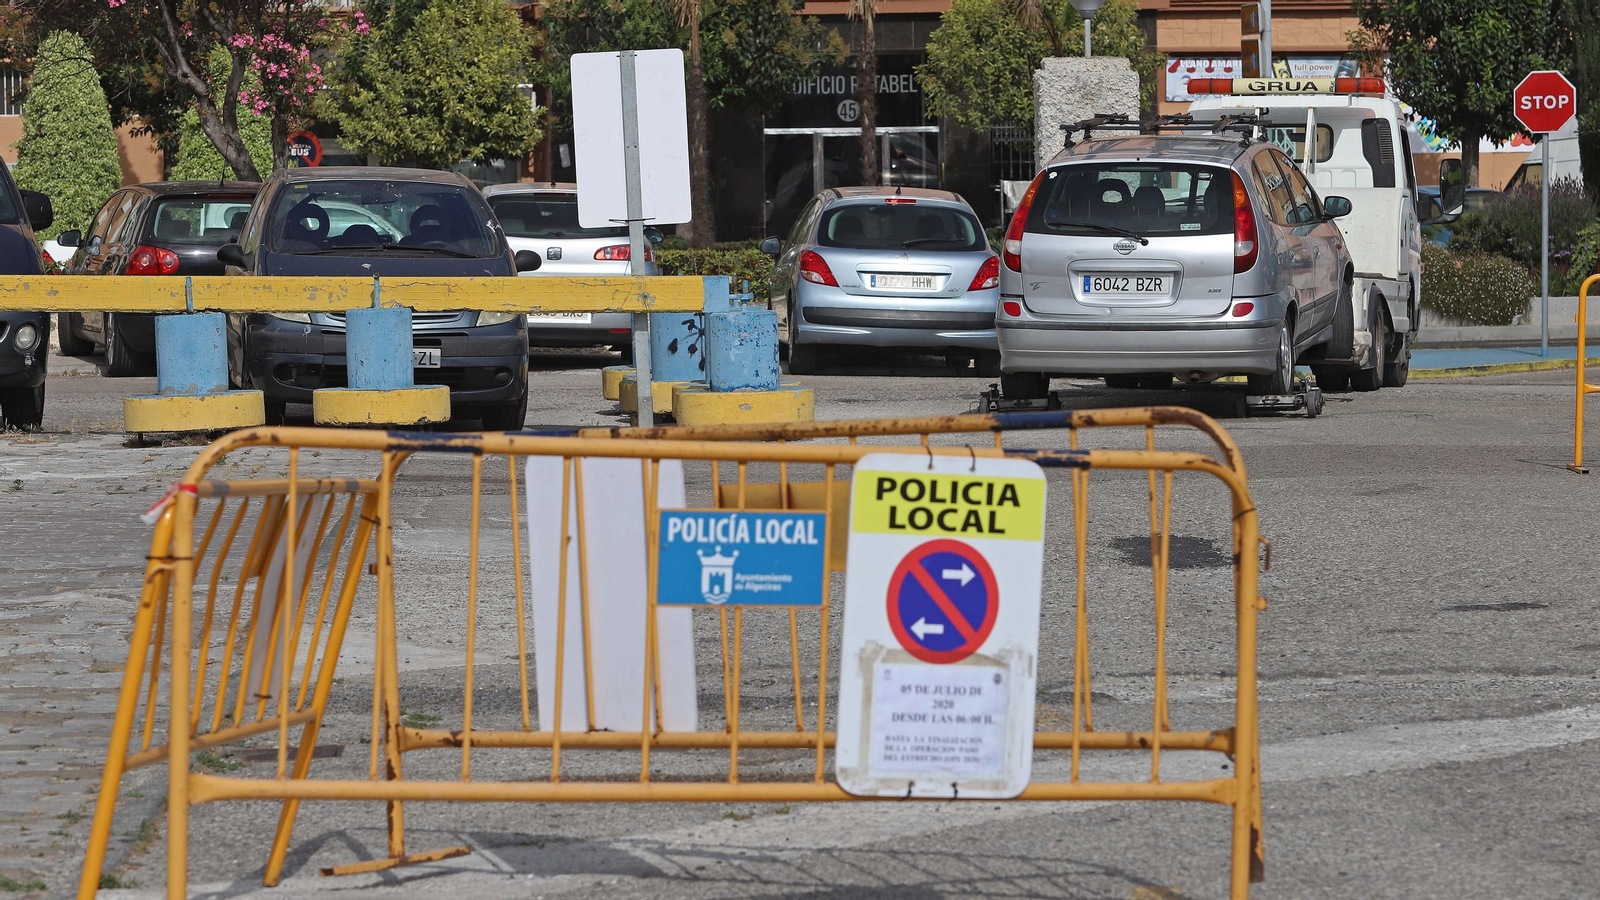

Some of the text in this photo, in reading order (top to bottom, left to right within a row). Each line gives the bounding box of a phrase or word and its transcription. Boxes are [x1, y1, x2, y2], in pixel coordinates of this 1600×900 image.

[1180, 59, 1210, 68] LLANO
[851, 74, 918, 94] RTABEL
[1248, 81, 1319, 92] GRUA
[1520, 94, 1569, 110] STOP
[839, 102, 857, 119] 45
[291, 148, 309, 156] BUS
[912, 277, 932, 288] HHW
[1093, 277, 1163, 292] 6042 BZR
[413, 351, 438, 366] ZL
[876, 477, 1021, 507] POLICIA
[888, 506, 1006, 534] LOCAL
[667, 513, 818, 545] POLICÍA LOCAL
[734, 572, 793, 584] Ayuntamiento
[734, 582, 782, 593] de Algeciras
[900, 685, 984, 696] 05 DE JULIO DE
[932, 700, 955, 710] 2020
[892, 713, 928, 723] DESDE
[932, 714, 953, 723] LAS
